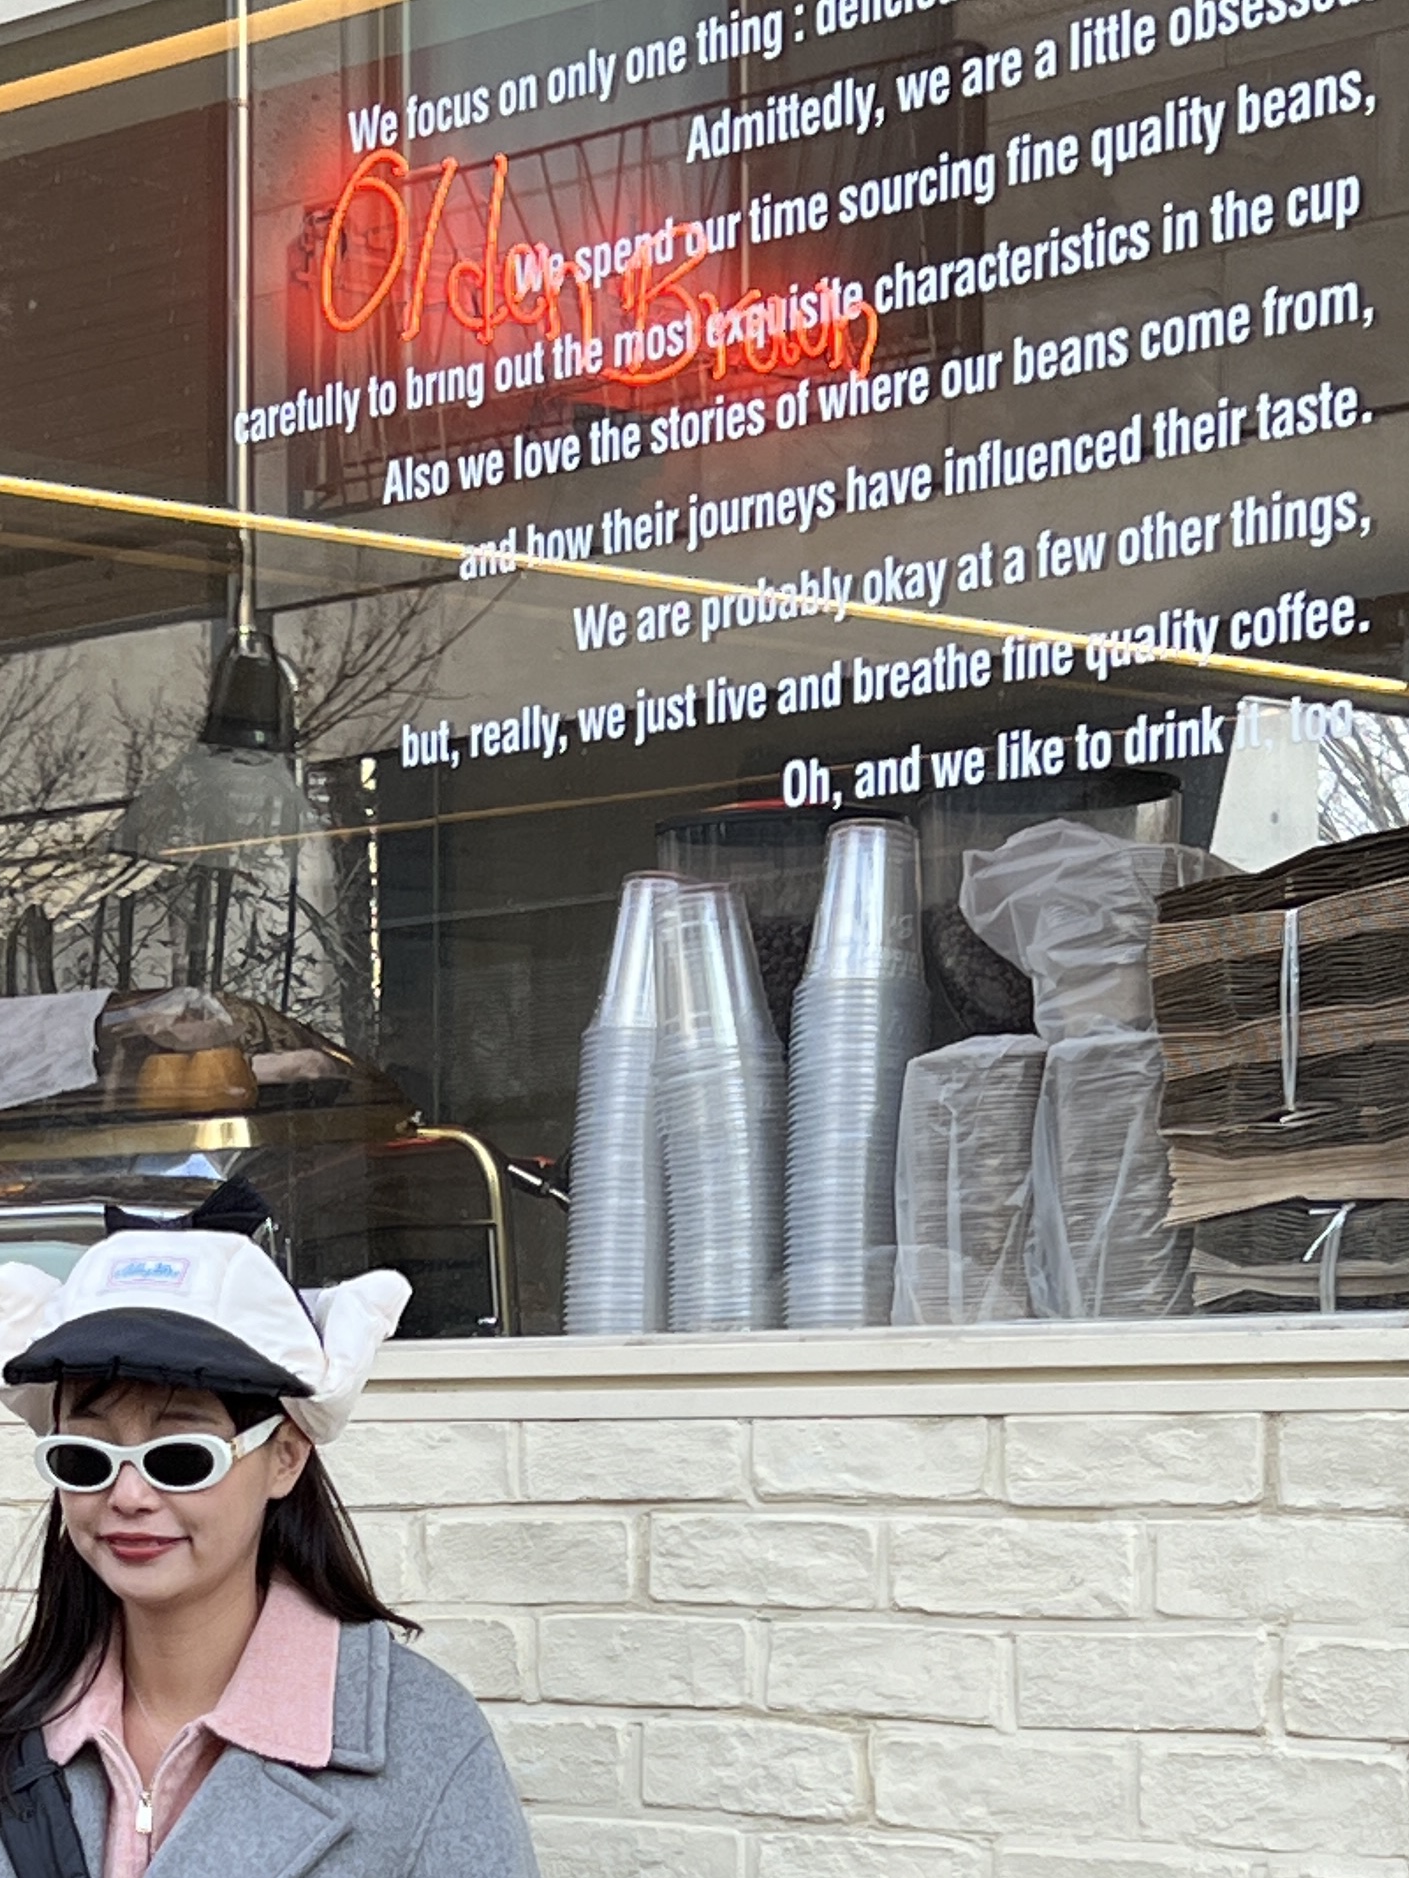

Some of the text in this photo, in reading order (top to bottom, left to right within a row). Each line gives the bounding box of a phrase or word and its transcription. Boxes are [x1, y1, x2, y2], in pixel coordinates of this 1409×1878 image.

[347, 103, 398, 154] We
[405, 85, 490, 141] focus
[498, 73, 538, 117] on
[547, 47, 617, 104] only
[625, 35, 687, 84] one
[695, 9, 783, 66] thing
[686, 78, 886, 164] Admittedly,
[895, 65, 950, 112] we
[961, 47, 1022, 97] are
[1034, 39, 1057, 80] a
[1069, 8, 1156, 71] little
[321, 148, 879, 386] Olden Brown
[514, 69, 1376, 296] We spend our time sourcing fine quality beans,
[233, 175, 1360, 448] carefully to bring out the most exquisite characteristics in the cup
[382, 281, 1374, 505] Also we love the stories of where our beans come from,
[458, 381, 1373, 582] and how their journeys have influenced their taste.
[572, 489, 1371, 652] We are probably okay at a few other things,
[402, 589, 1370, 769] but, really, we just live and breathe fine quality coffee.
[783, 757, 842, 810] Oh,
[854, 744, 921, 799] and
[930, 746, 985, 789] we
[997, 729, 1064, 781] like
[1074, 724, 1112, 771] to
[1124, 705, 1225, 765] drink
